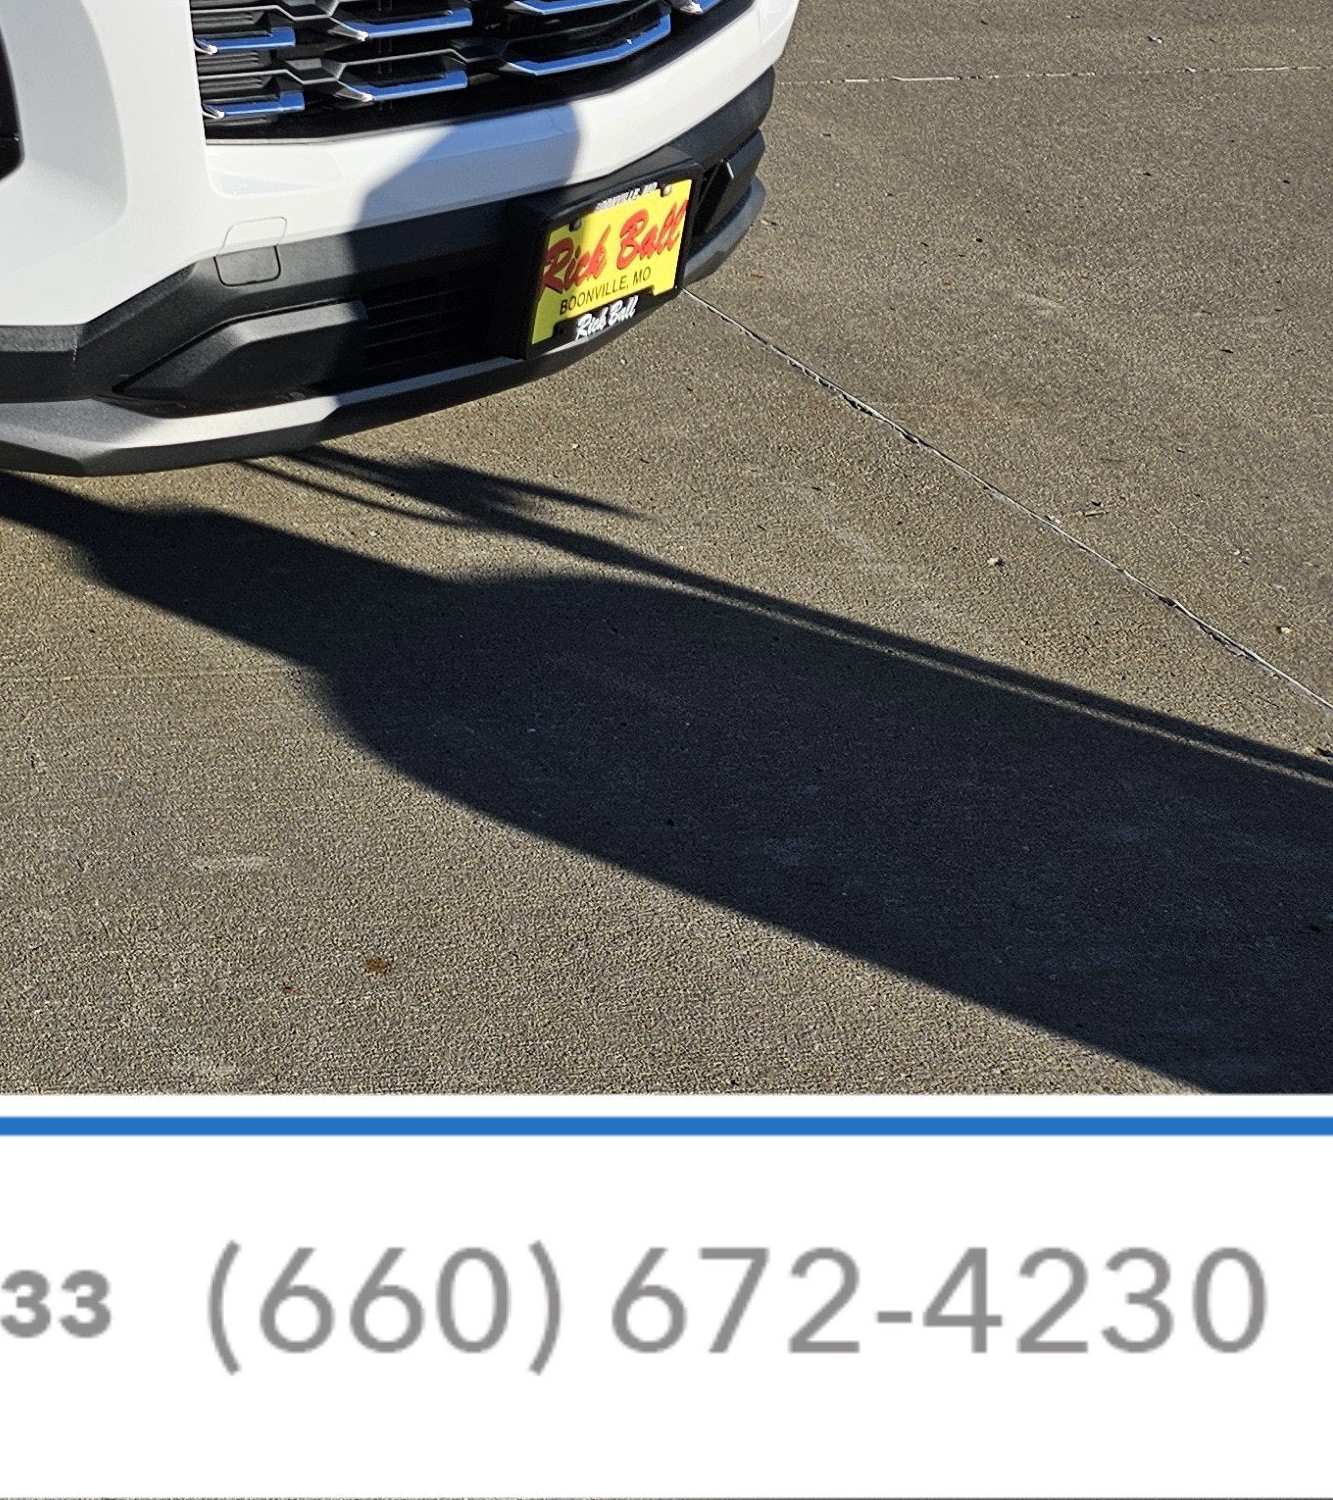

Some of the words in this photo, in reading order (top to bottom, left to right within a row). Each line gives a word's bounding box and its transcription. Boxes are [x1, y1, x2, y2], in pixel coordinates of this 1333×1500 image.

[541, 223, 611, 295] Rick
[616, 199, 688, 270] Ball
[559, 274, 629, 316] BOONVILLE,
[632, 266, 652, 286] MO
[575, 305, 608, 341] Rick
[608, 294, 639, 327] Ball
